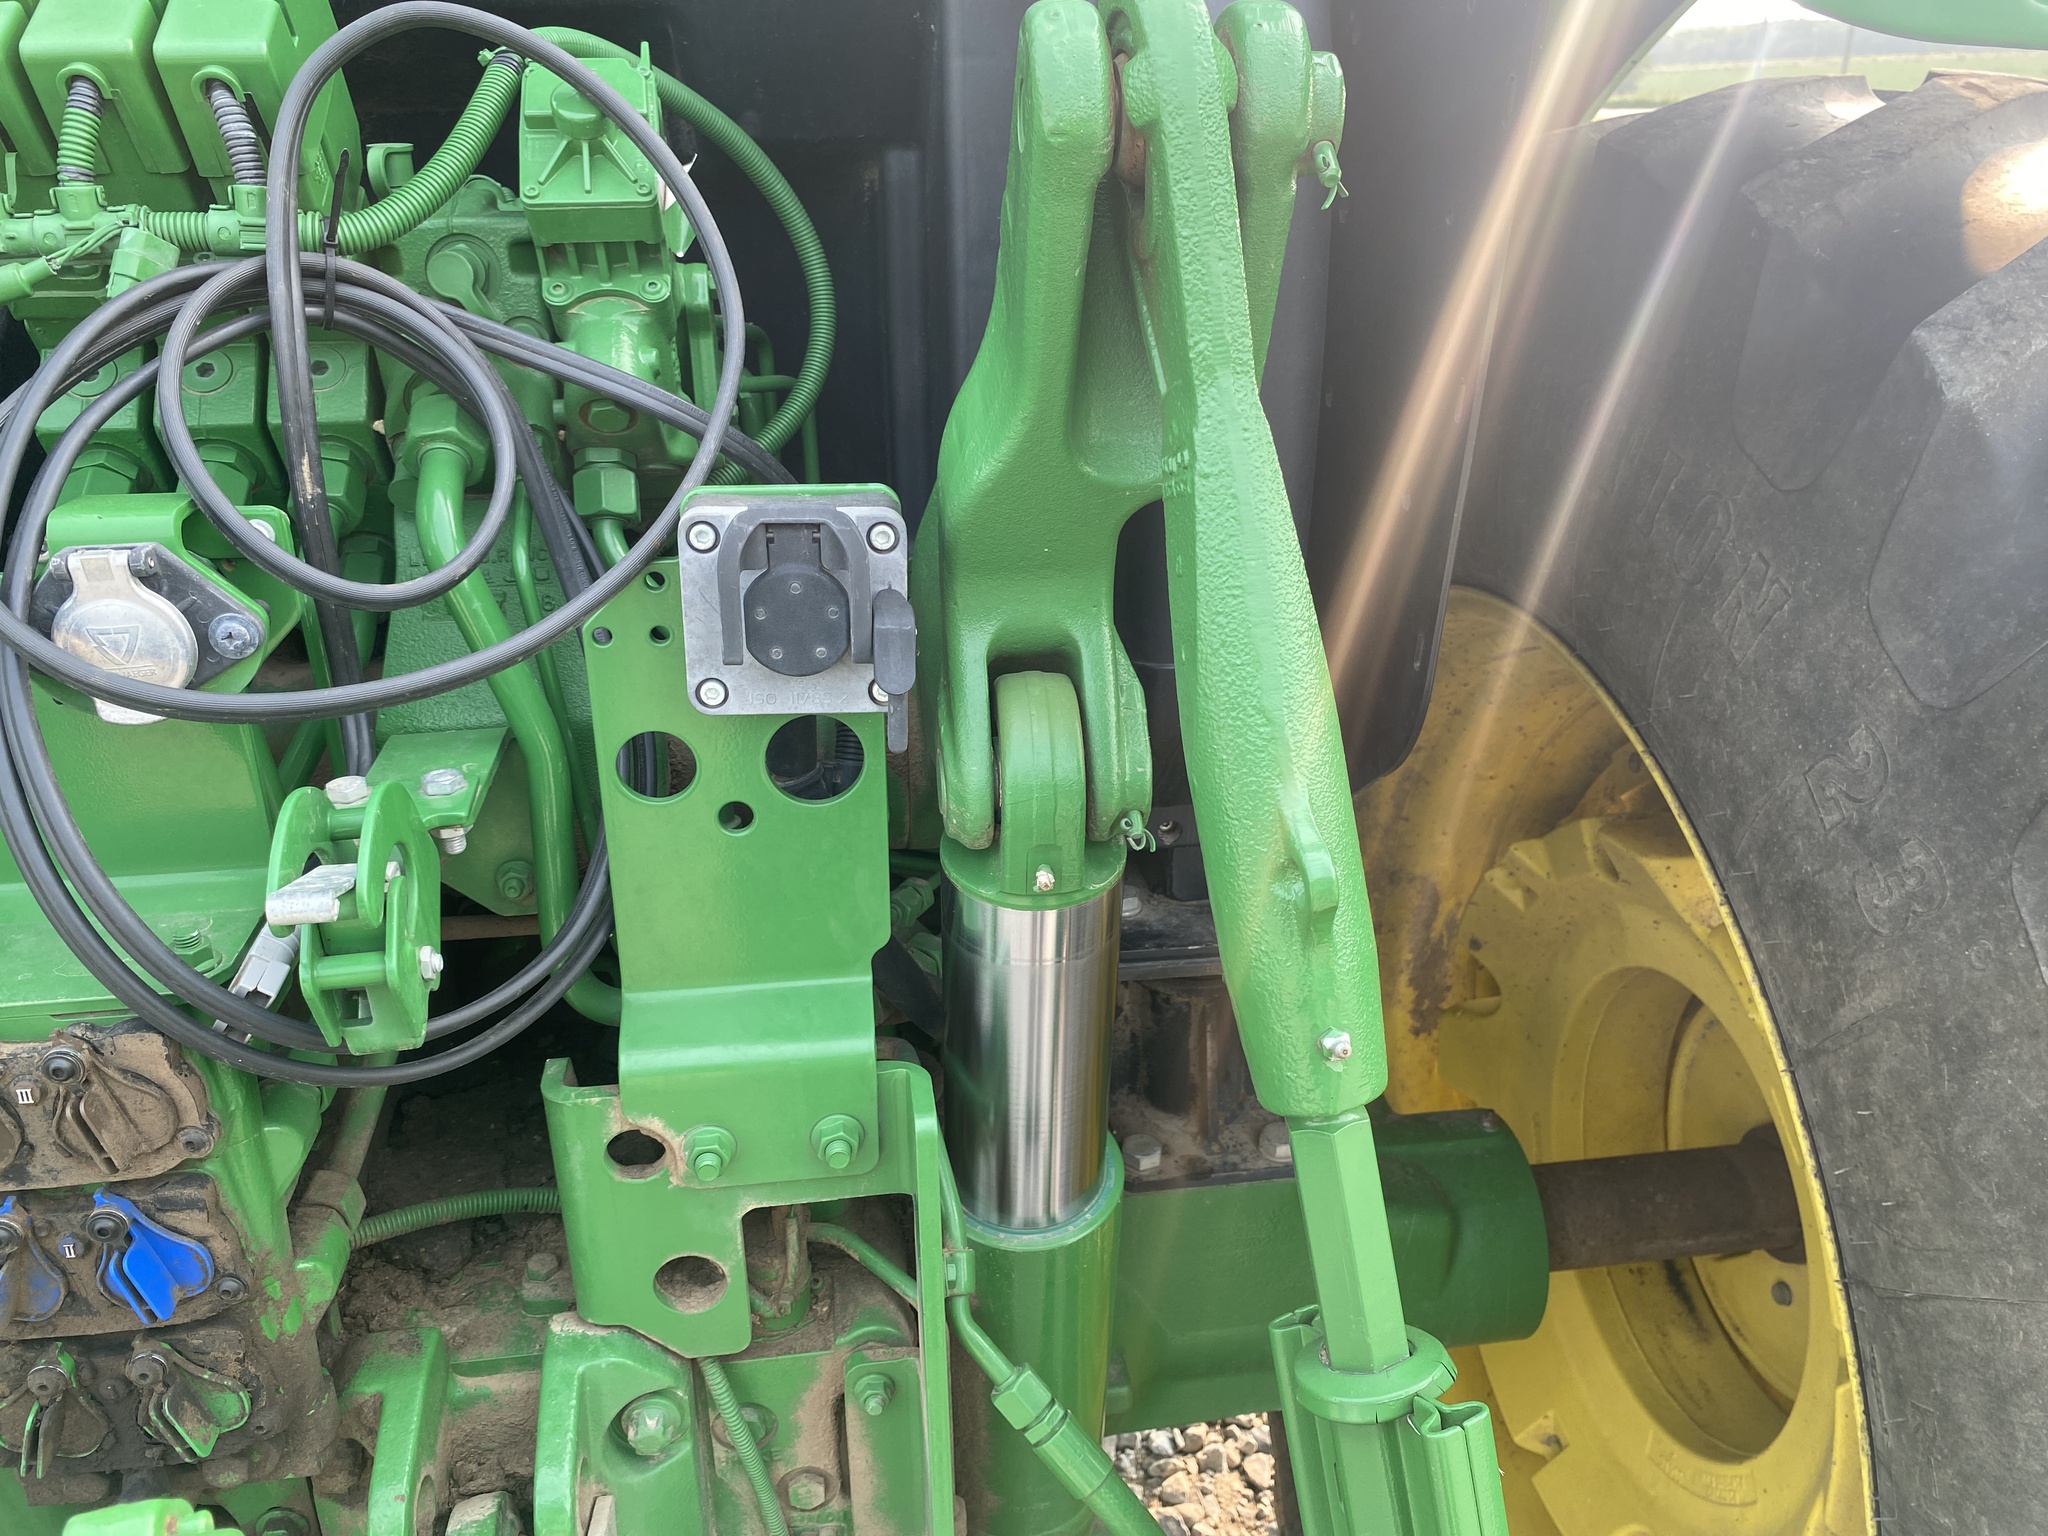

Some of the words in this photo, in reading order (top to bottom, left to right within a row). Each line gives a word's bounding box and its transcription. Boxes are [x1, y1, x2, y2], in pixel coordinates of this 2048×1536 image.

[748, 692, 777, 705] ISO
[15, 1088, 35, 1104] III
[62, 1244, 76, 1259] II
